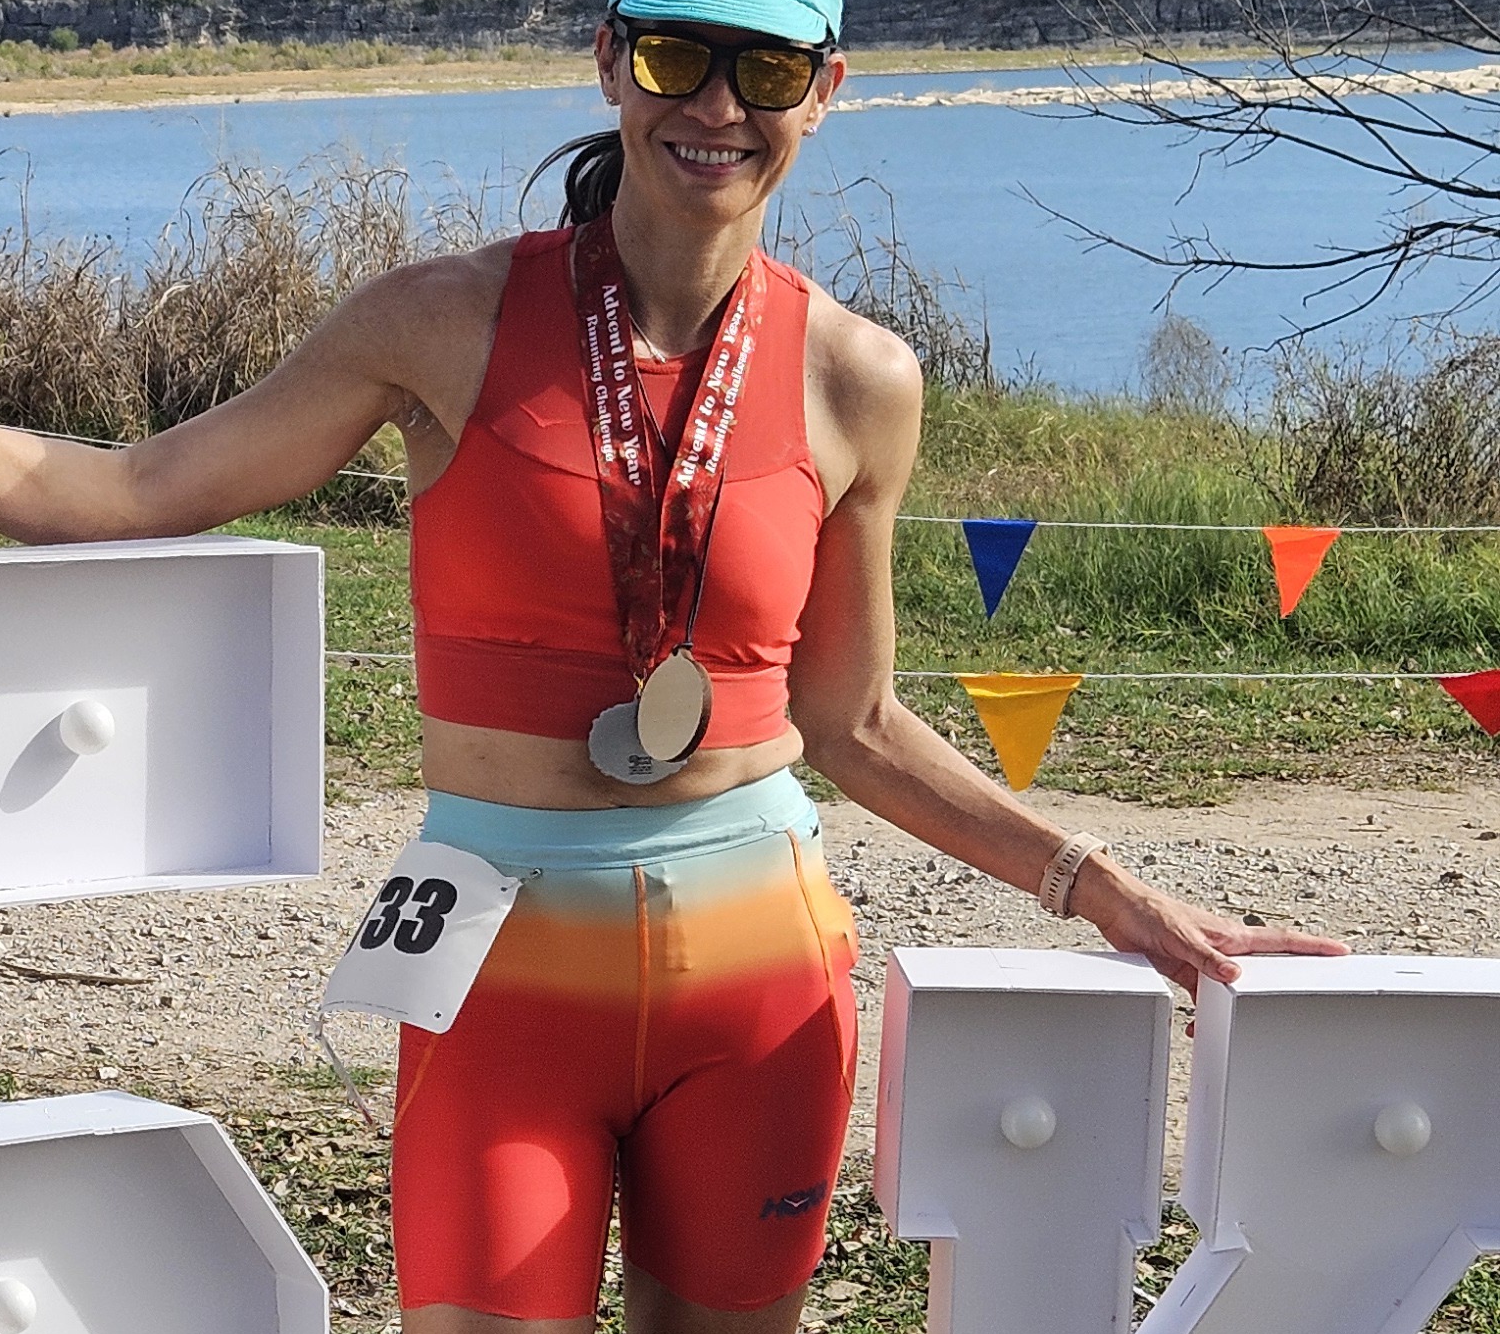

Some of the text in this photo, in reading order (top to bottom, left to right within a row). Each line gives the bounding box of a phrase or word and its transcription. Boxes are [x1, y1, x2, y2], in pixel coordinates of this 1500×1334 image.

[586, 314, 614, 462] Running Challenge
[601, 284, 641, 486] Advent to New Year
[676, 298, 745, 489] Advent to New Year
[705, 335, 754, 475] Running Challenge
[346, 876, 458, 955] 33
